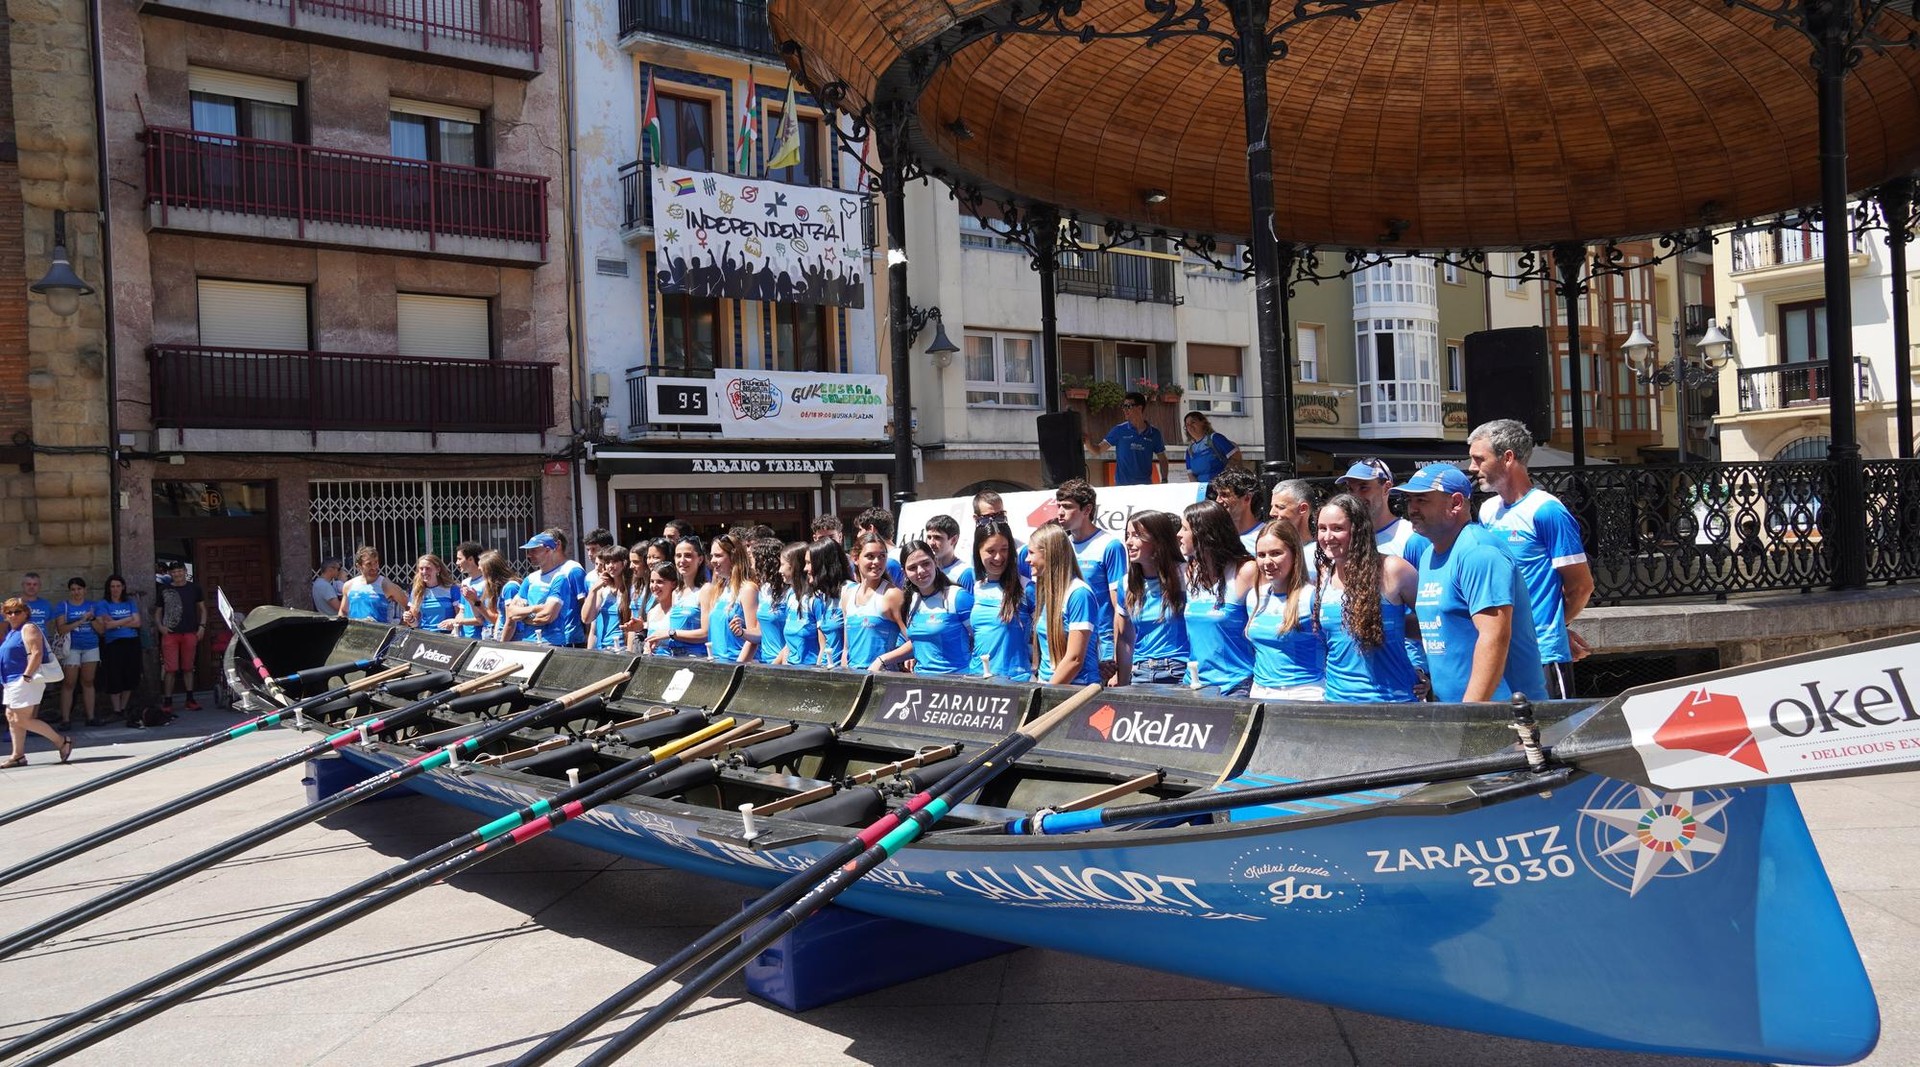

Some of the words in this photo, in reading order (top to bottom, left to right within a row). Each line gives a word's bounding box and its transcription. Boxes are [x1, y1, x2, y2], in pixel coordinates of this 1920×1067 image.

[791, 383, 822, 404] GUK
[820, 383, 872, 394] EUSKAL
[679, 392, 701, 409] 95
[692, 459, 761, 473] ARRANO
[765, 460, 834, 472] TABERNA
[928, 692, 1011, 715] ZARAUTZ
[922, 710, 1004, 730] SERIGRAFIA
[1811, 741, 1896, 761] DELICIOUS
[1366, 825, 1568, 873] ZARAUTZ
[1287, 863, 1331, 877] denda
[1467, 854, 1575, 887] 2030
[945, 864, 1214, 909] SALANORT
[1267, 876, 1333, 904] Ja
